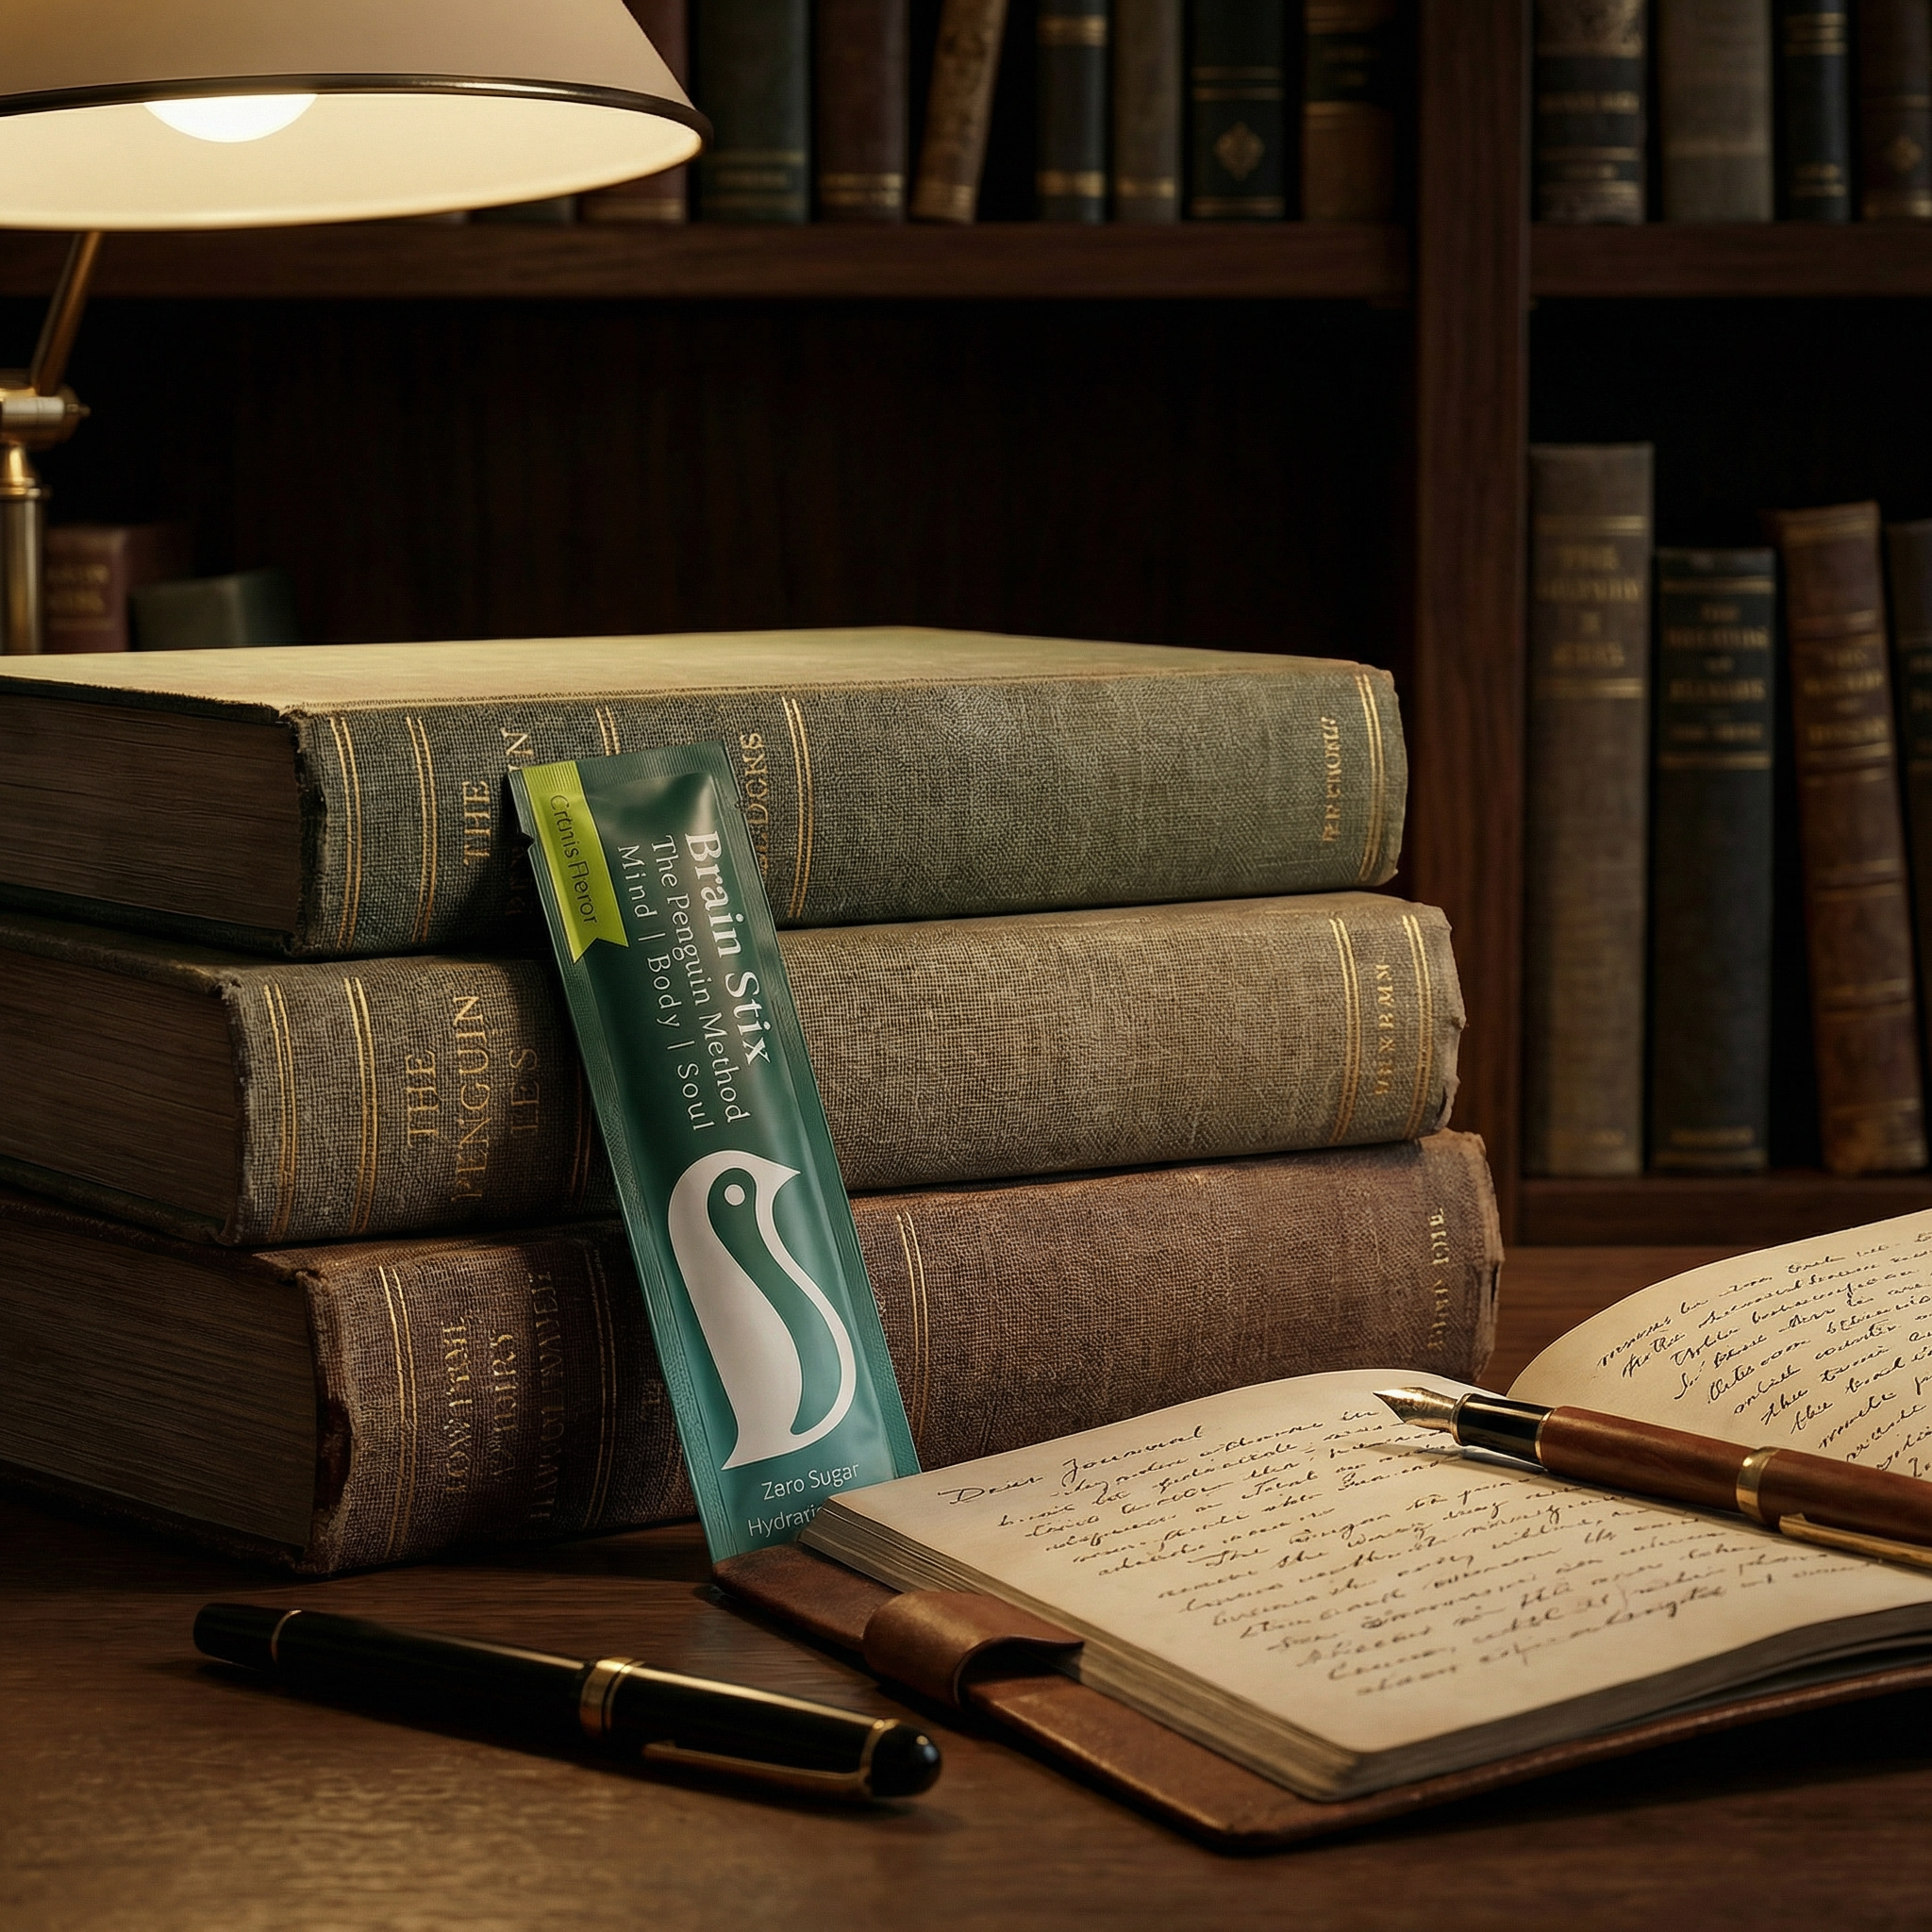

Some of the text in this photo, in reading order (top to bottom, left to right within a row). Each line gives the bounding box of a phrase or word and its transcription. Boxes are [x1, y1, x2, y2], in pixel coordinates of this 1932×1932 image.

[462, 781, 491, 865] THE
[617, 843, 658, 920] Mind
[647, 956, 683, 1027] Body
[677, 1062, 716, 1132] Soul
[651, 834, 752, 1124] The Penguin Method
[685, 830, 771, 1065] Brain Stix
[406, 1050, 439, 1147] THE
[451, 995, 491, 1203] PENGUIN
[808, 1463, 859, 1488] Sugar
